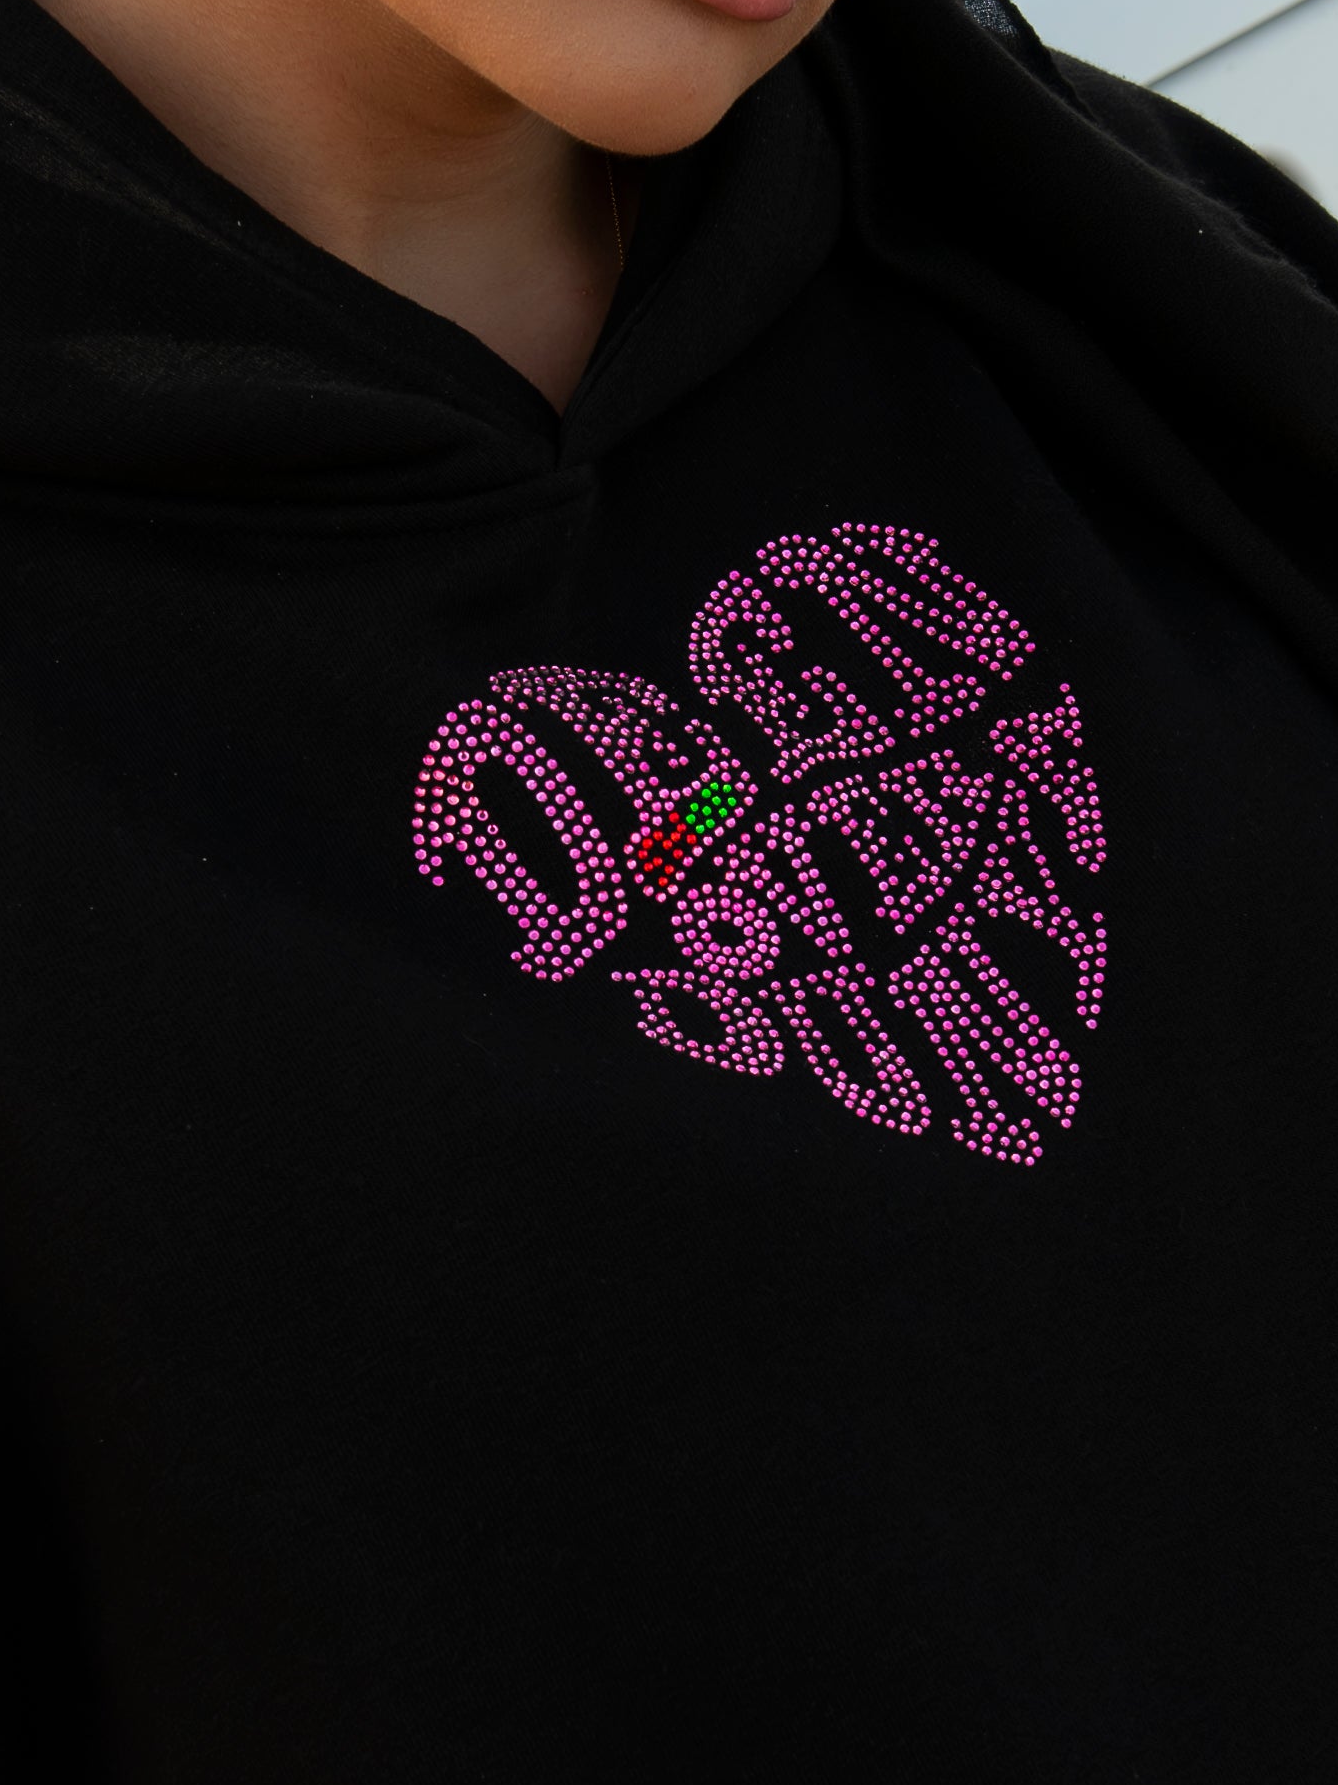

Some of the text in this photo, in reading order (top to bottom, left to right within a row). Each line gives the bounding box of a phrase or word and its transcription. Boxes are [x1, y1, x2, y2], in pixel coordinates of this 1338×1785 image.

[411, 521, 1036, 983] DEEN
[610, 682, 1108, 1167] DUNYA
[670, 749, 995, 978] OVER
